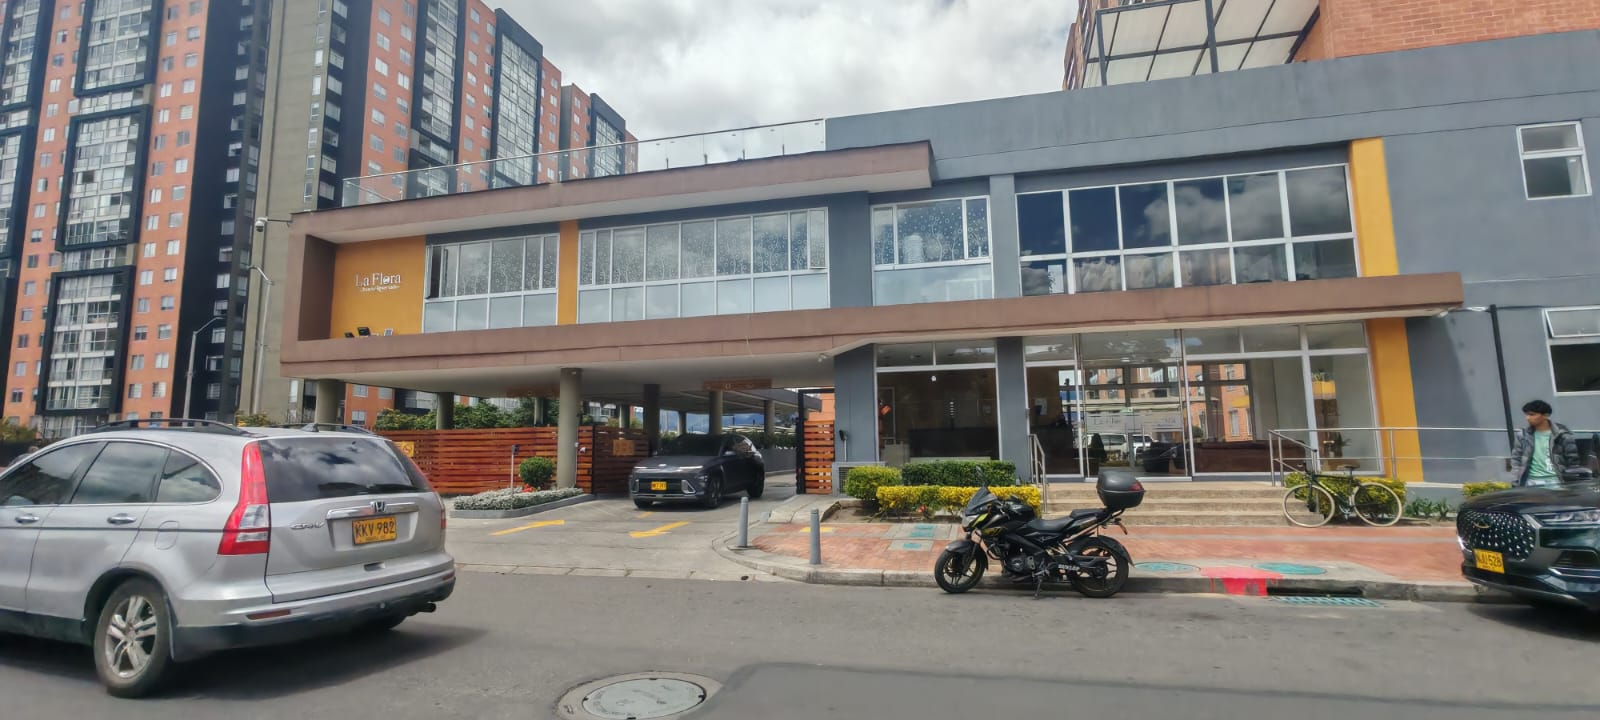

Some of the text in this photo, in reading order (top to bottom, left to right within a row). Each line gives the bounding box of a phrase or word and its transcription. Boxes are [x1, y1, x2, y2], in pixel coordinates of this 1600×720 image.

[354, 272, 401, 287] La Flora
[354, 523, 374, 538] KKV
[376, 520, 395, 534] 982
